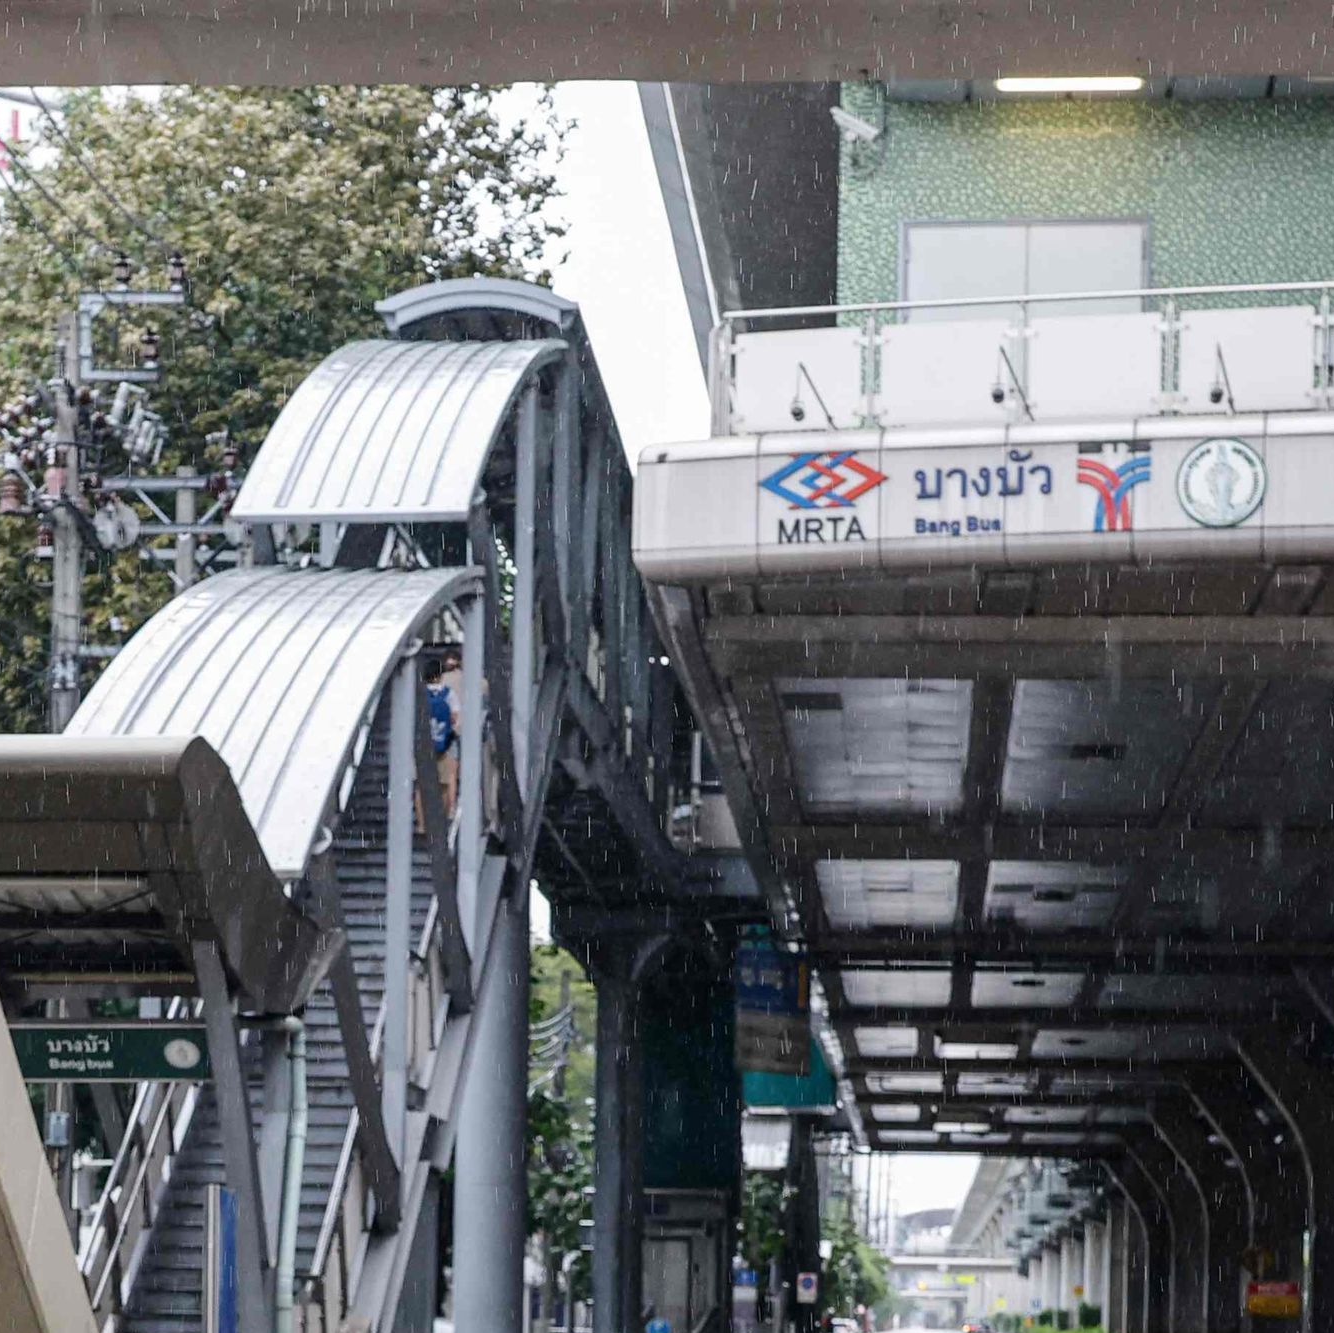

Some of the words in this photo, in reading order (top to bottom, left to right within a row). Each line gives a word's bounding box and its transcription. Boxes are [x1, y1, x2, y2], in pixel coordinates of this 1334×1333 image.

[915, 450, 1053, 500] บางบัว
[777, 516, 867, 545] MRTA
[915, 517, 961, 537] Bang
[967, 515, 1002, 533] Bua
[46, 1034, 112, 1054] บางบัว
